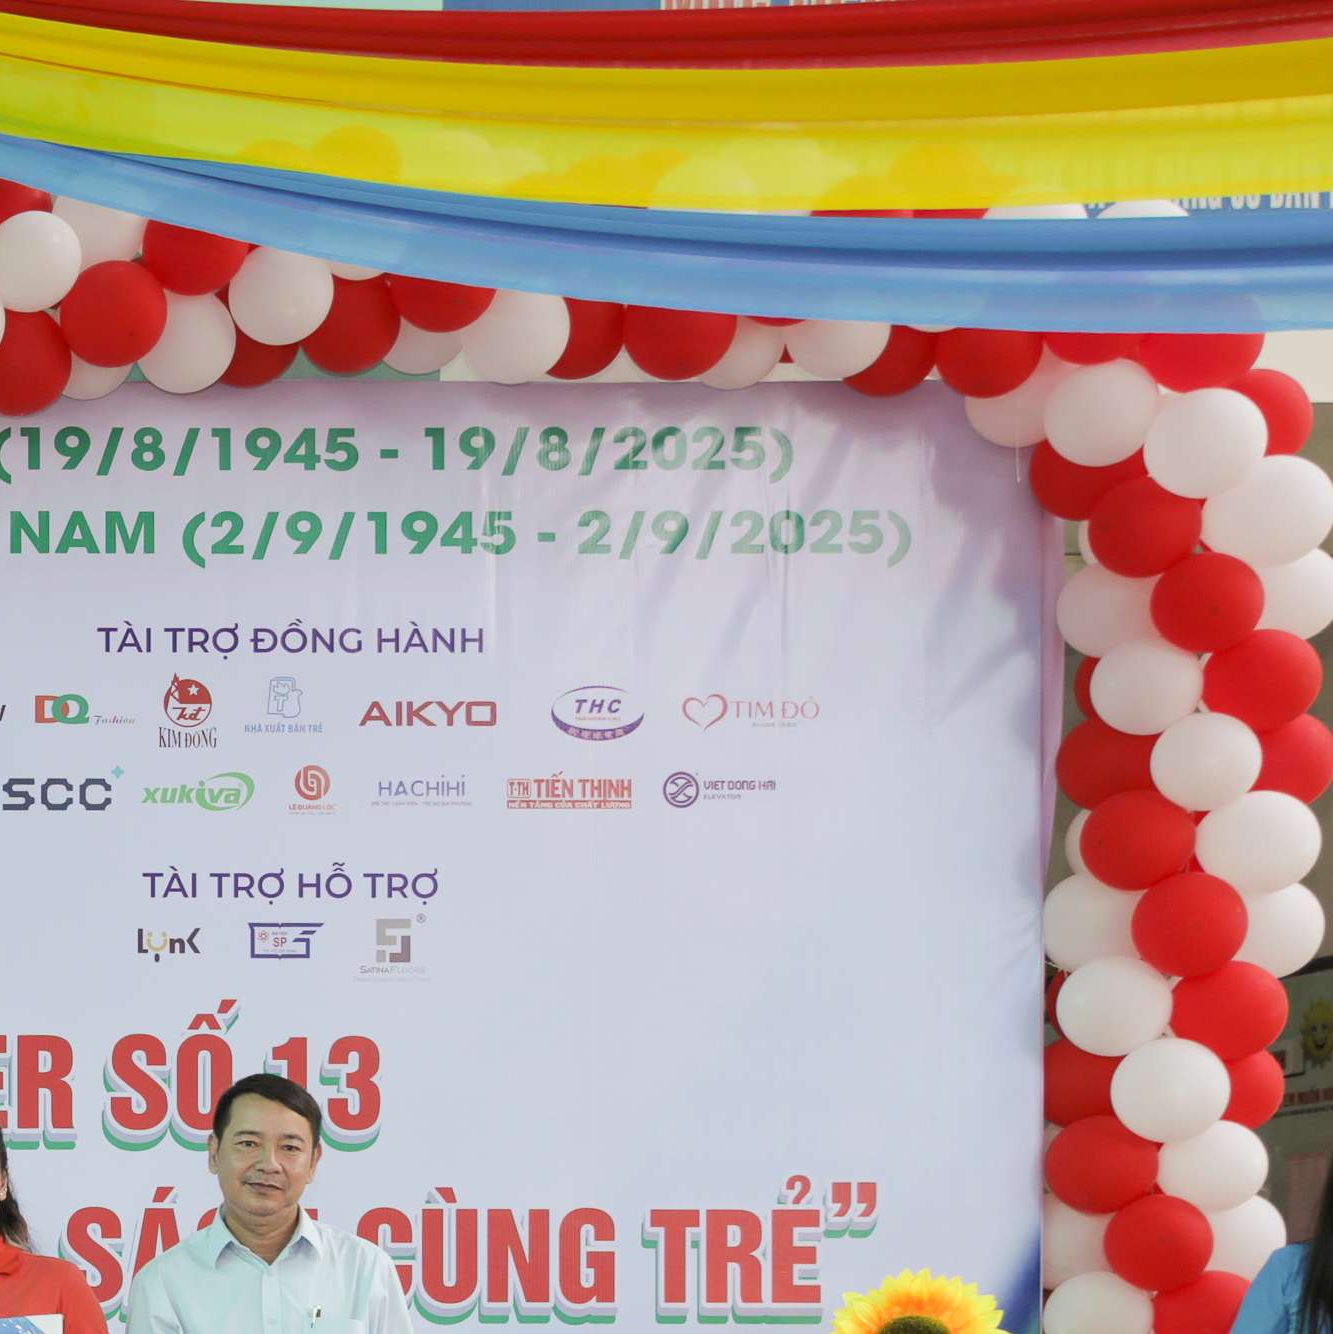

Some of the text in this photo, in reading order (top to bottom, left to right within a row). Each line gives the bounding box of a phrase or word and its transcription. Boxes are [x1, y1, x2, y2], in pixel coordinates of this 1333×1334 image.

[425, 425, 794, 483] 19/8/2025)
[10, 511, 155, 554] NAM
[182, 511, 516, 569] (2/9/1945
[578, 508, 913, 570] 2/9/2025)
[97, 619, 483, 660] TÀI TRỢ ĐỒNG HÀNH
[35, 693, 90, 724] DQ
[358, 700, 497, 727] AIKYO
[574, 699, 622, 714] THC
[734, 700, 774, 719] TIM
[159, 727, 181, 748] KIM
[2, 778, 112, 811] SCC
[534, 771, 573, 798] TIẾN
[142, 862, 438, 905] TÀI TRỢ HỖ TRỢ
[111, 999, 237, 1130] SỐ
[357, 1187, 616, 1304] CÙNG
